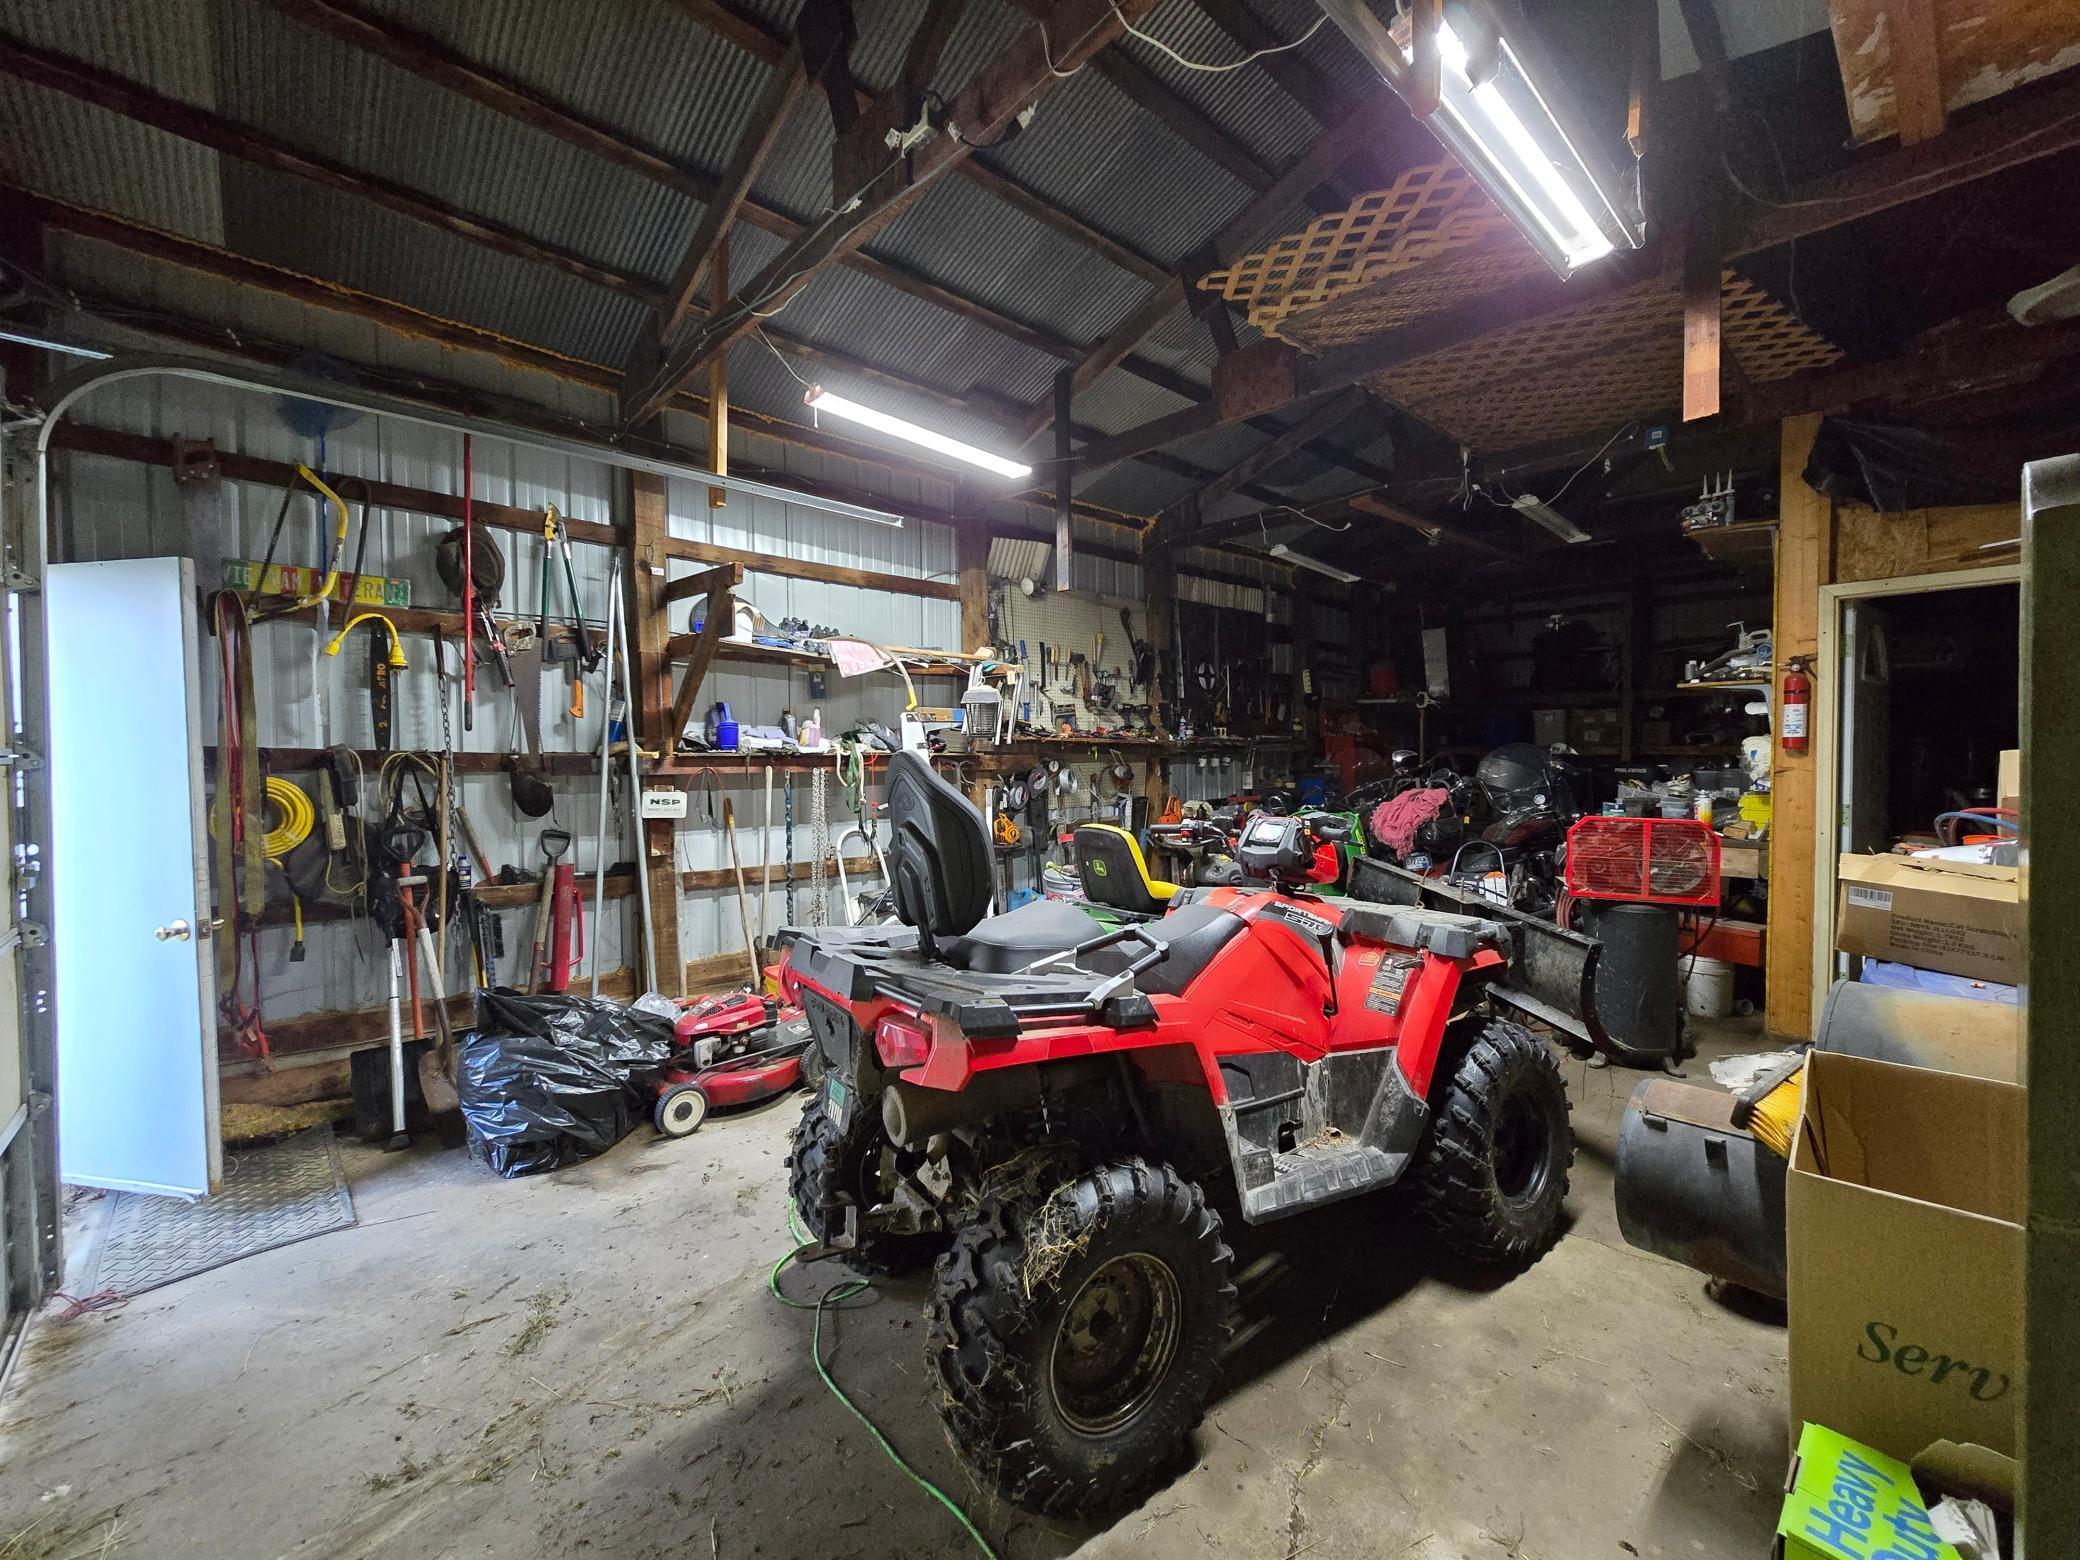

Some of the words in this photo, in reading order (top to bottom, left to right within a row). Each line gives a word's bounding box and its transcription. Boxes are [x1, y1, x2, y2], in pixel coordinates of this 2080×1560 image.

[222, 564, 301, 595] VIENAM
[650, 798, 681, 806] NSP
[1857, 1321, 2010, 1401] Serv
[1804, 1449, 1895, 1560] Heavy
